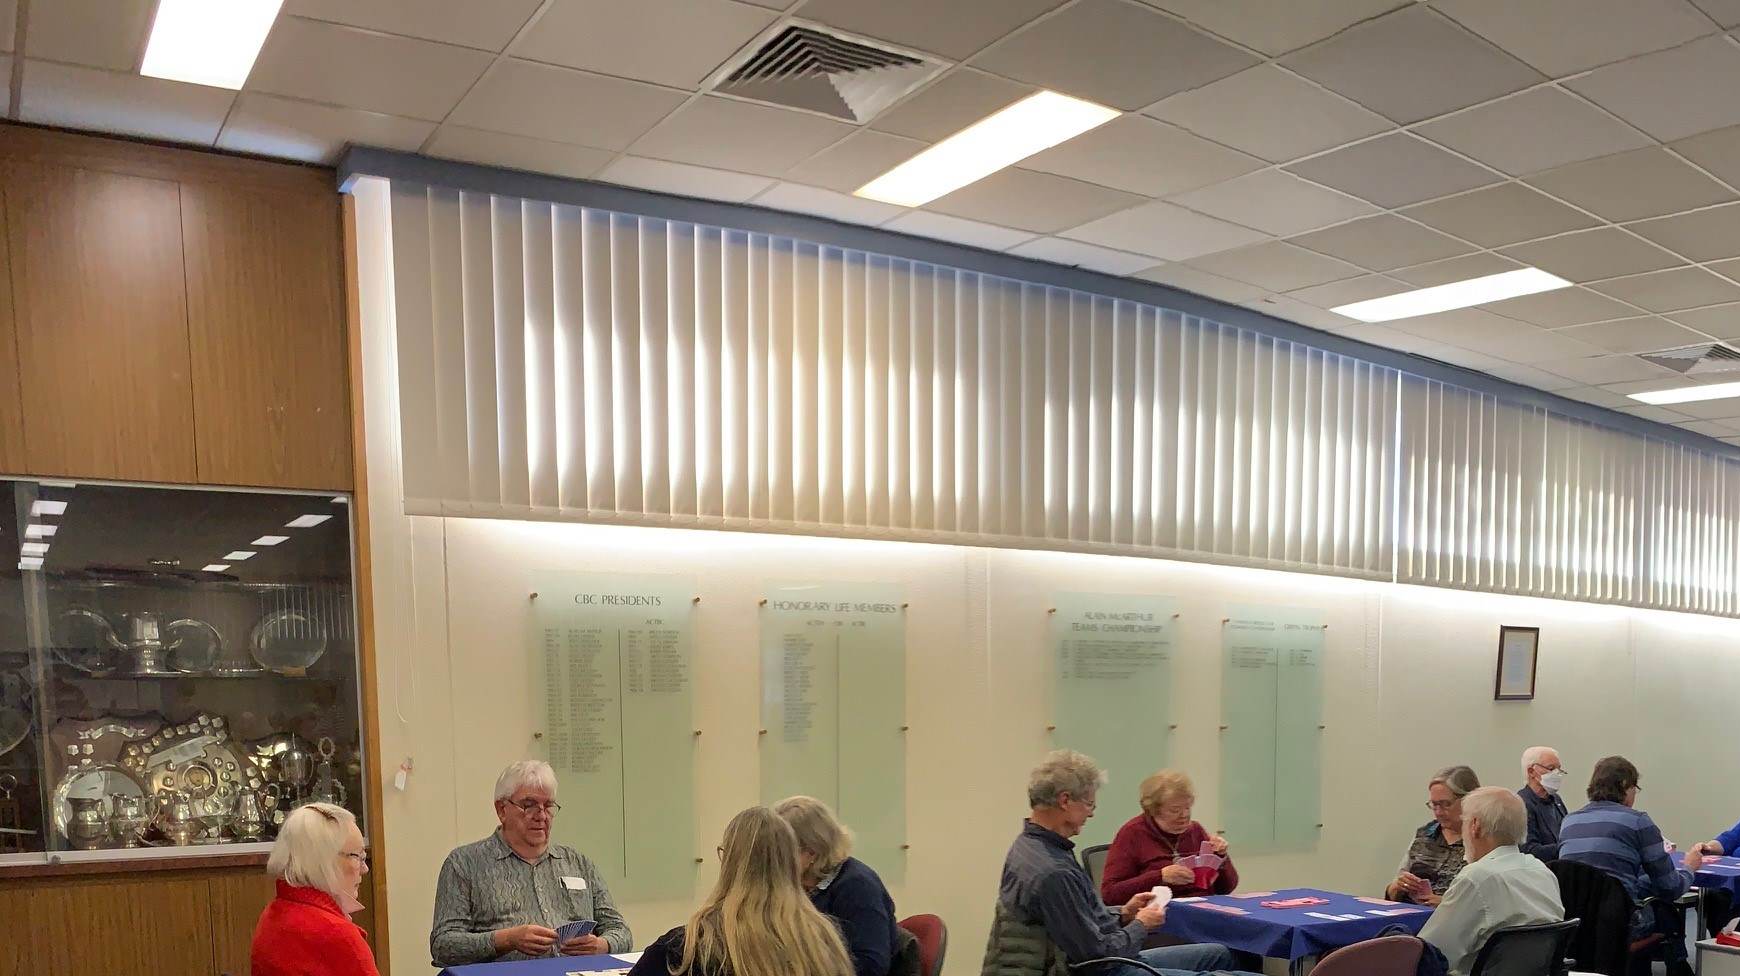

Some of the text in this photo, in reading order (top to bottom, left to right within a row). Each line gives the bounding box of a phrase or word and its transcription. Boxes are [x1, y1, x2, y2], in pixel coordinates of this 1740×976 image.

[574, 593, 662, 606] CBC PRESIDENTS
[773, 601, 897, 613] HONORARY LIFE MEMBERS
